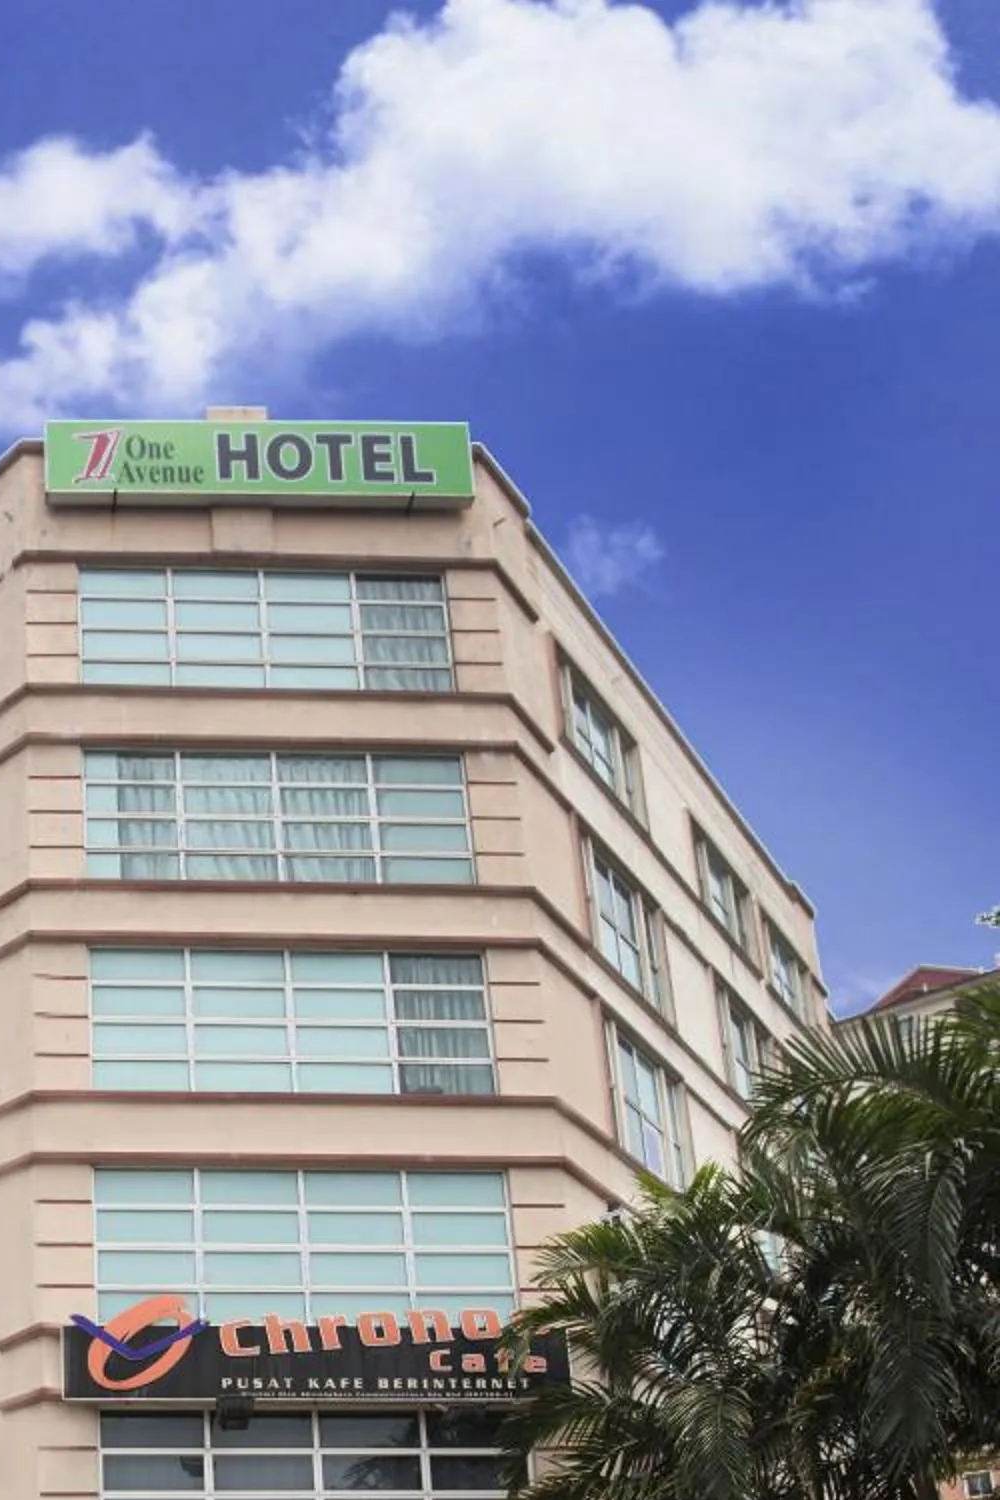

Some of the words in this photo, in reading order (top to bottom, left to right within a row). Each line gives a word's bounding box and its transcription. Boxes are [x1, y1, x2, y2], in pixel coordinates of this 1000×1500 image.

[125, 434, 176, 461] One
[216, 432, 437, 484] HOTEL
[118, 461, 205, 485] Avenue
[221, 1376, 294, 1389] PUSAT
[308, 1376, 364, 1389] KAFE
[377, 1376, 530, 1389] BERINTERNET
